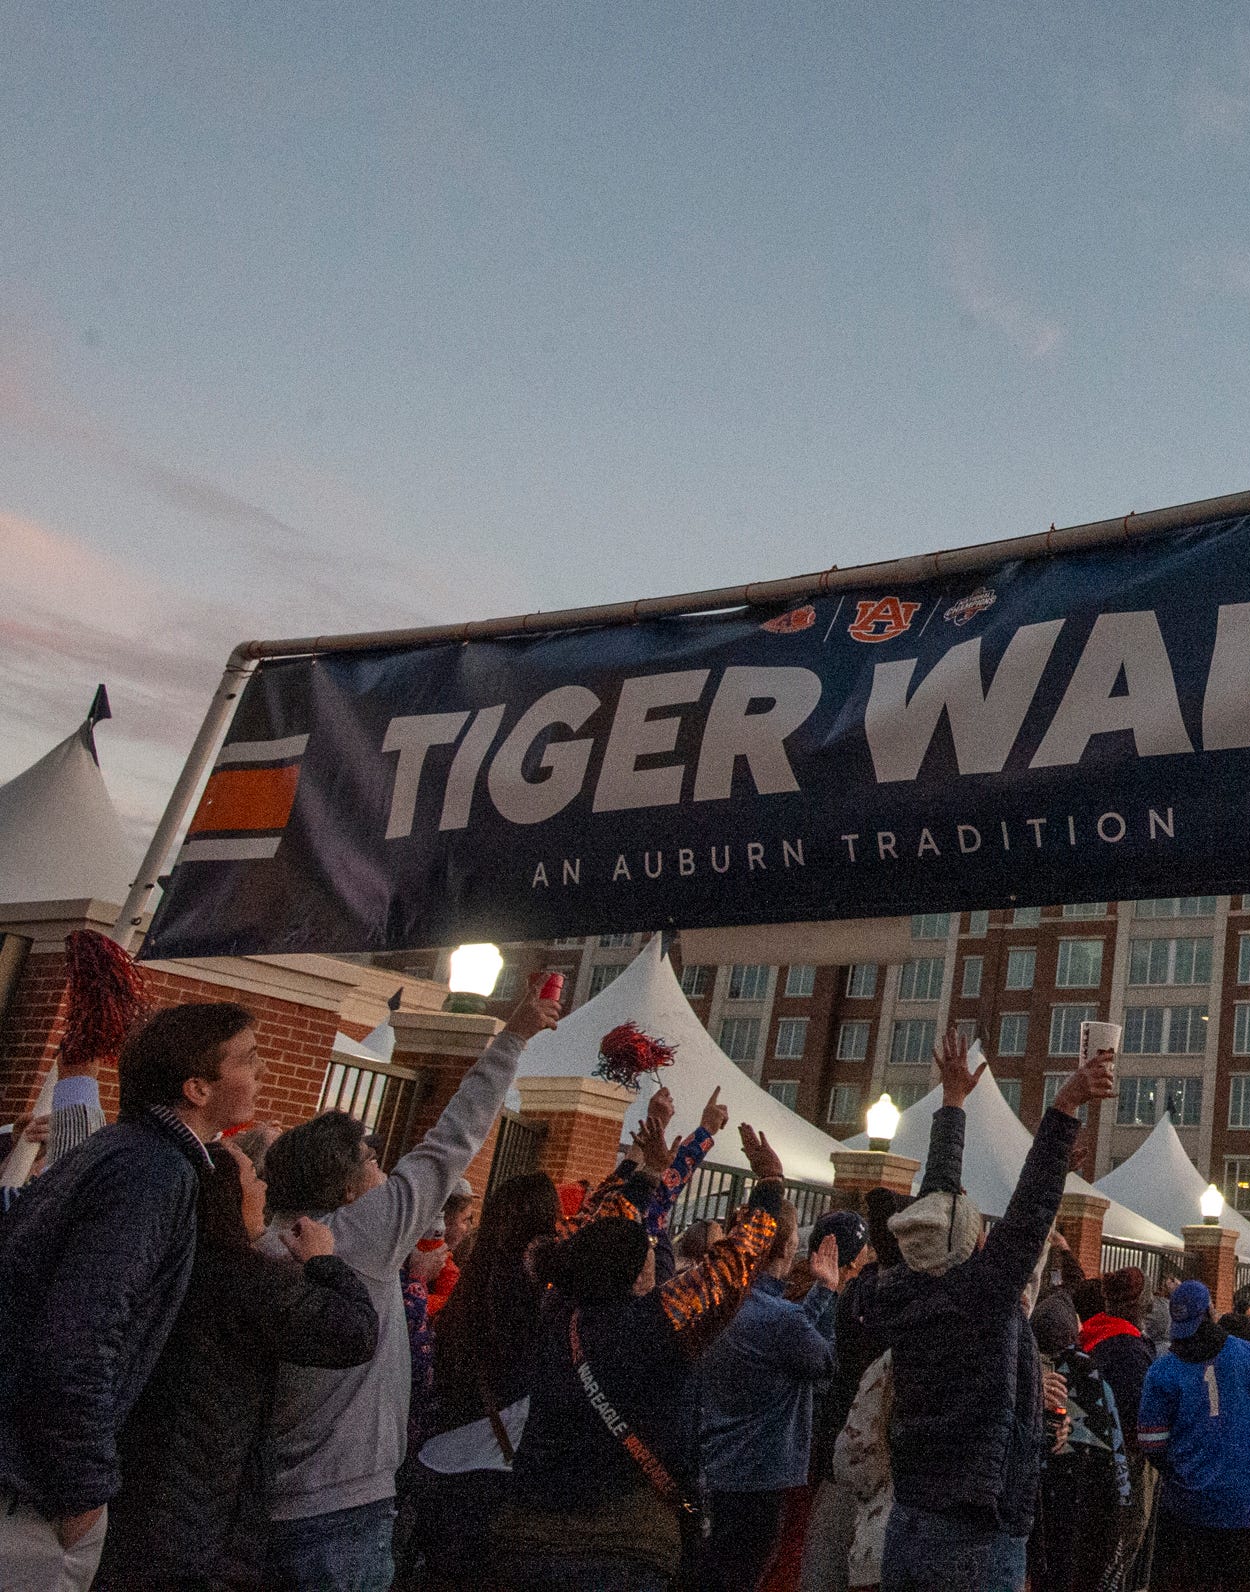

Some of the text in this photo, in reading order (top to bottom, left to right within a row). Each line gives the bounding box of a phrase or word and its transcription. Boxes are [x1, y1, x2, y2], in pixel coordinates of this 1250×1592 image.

[382, 666, 822, 840] TIGER
[532, 807, 1177, 888] AN AUBURN TRADITION
[577, 1361, 628, 1436] WAR EAGLE
[1203, 1364, 1220, 1417] 1
